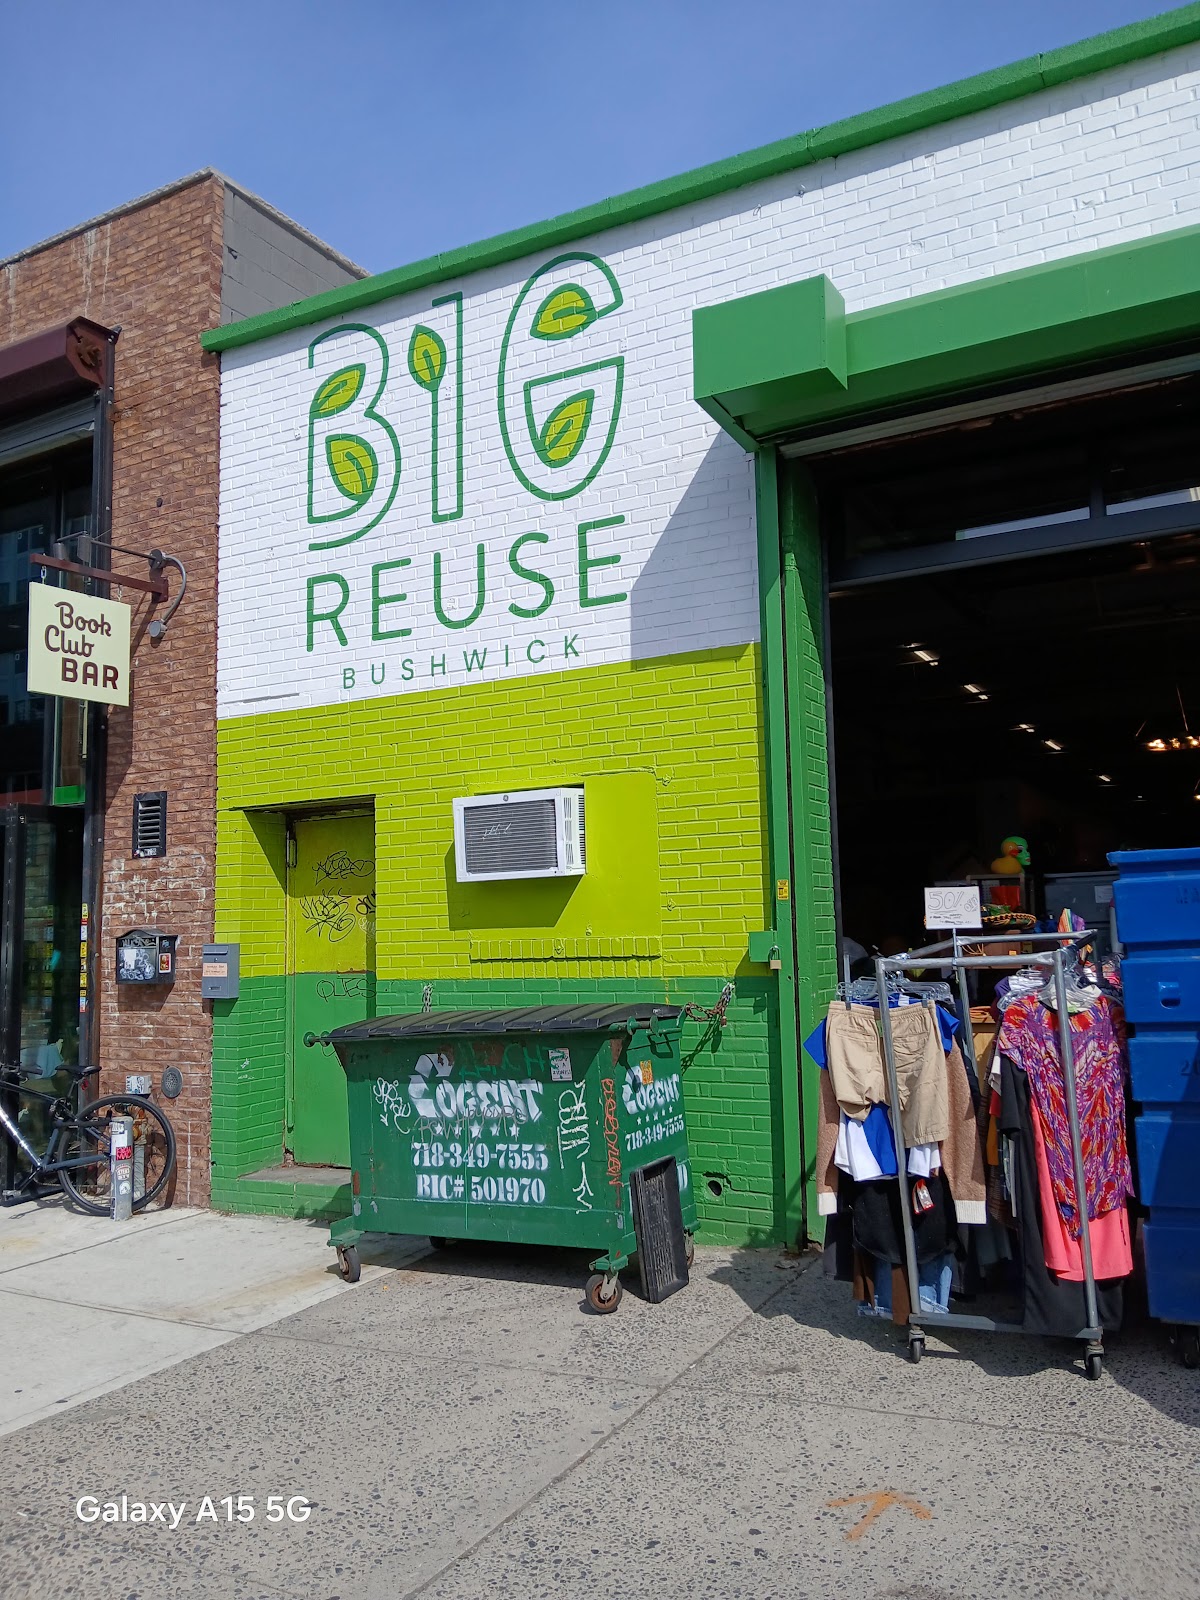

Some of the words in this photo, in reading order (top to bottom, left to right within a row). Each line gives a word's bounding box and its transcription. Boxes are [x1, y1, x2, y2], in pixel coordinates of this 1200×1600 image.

[306, 252, 625, 551] BIG
[306, 514, 629, 652] REUSE
[54, 601, 112, 637] Book
[44, 624, 95, 658] Club
[61, 656, 120, 690] BAR
[342, 633, 581, 690] BUSHWICK
[624, 1113, 685, 1152] 718-349-7555
[411, 1142, 550, 1172] 718-349-7555
[416, 1173, 465, 1201] BIC#
[471, 1175, 547, 1204] 501970
